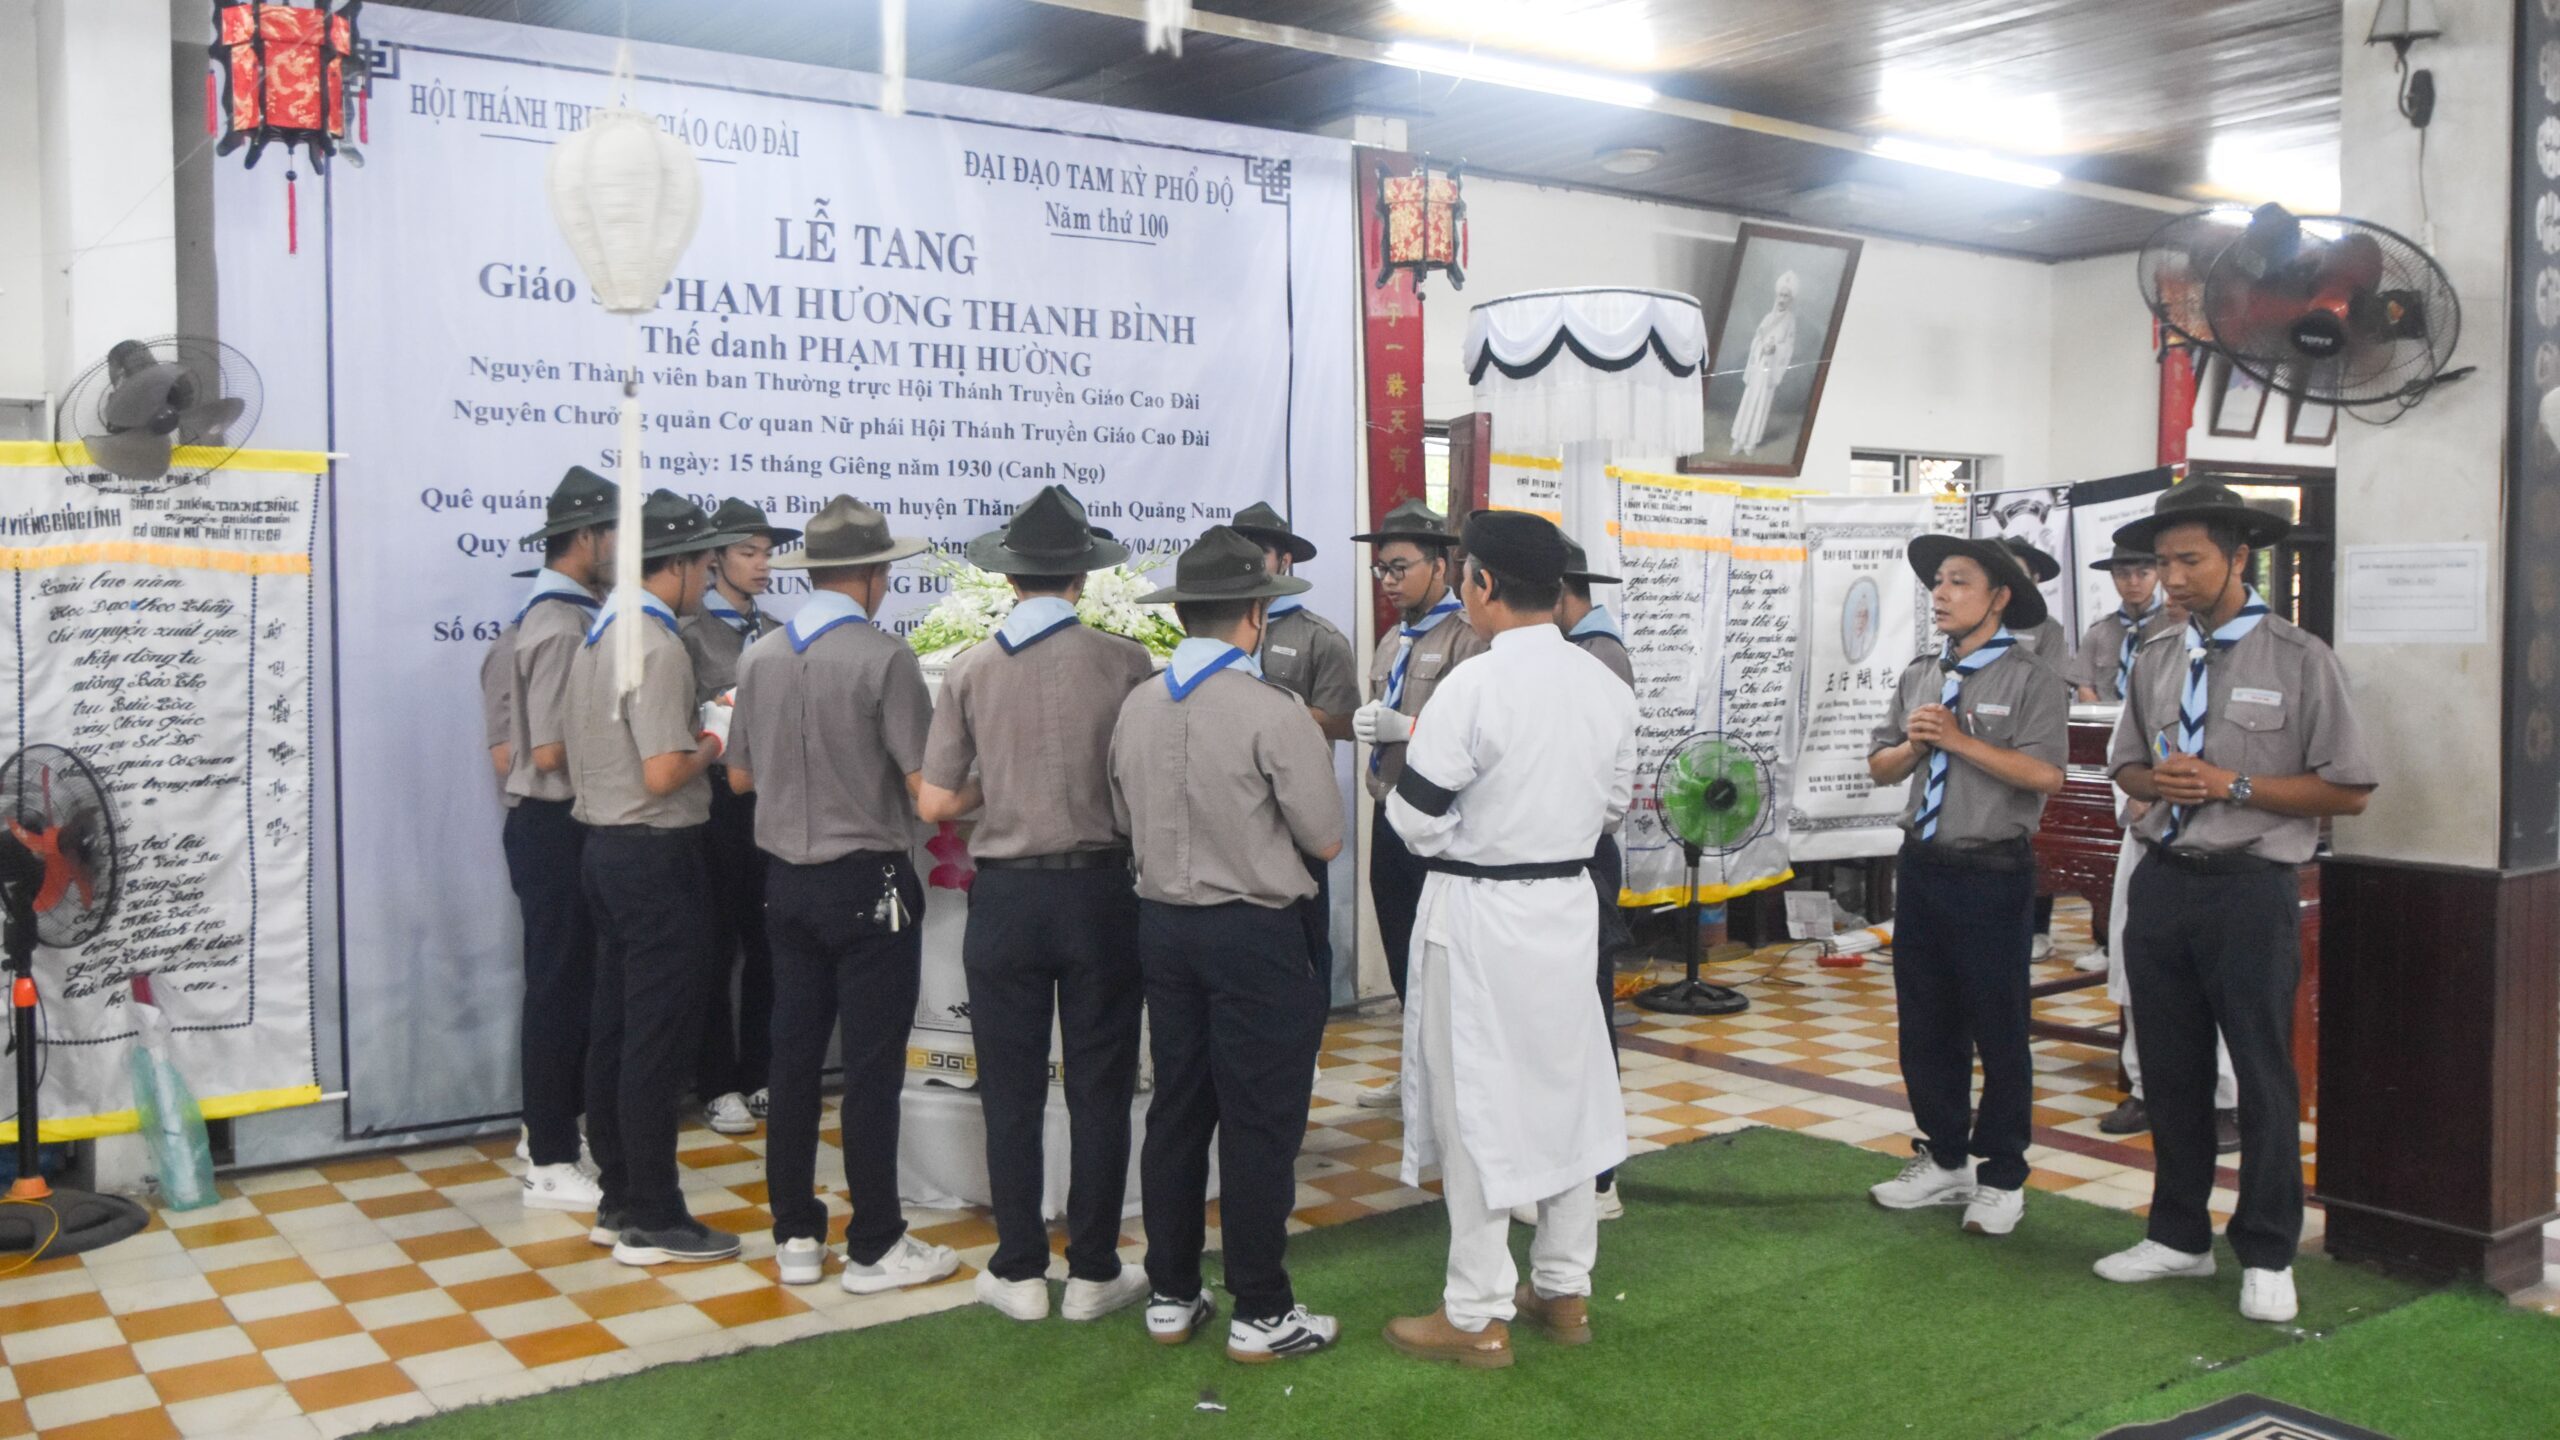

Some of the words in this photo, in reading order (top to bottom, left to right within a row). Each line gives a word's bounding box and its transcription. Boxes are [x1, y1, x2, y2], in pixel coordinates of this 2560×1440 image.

[410, 77, 456, 125] HỘI
[464, 85, 547, 129] THÁNH
[715, 122, 756, 153] CAO
[762, 120, 799, 158] ĐÀI
[964, 151, 1005, 185] ĐẠI
[1012, 156, 1060, 190] ĐẠO
[1066, 164, 1113, 194] TAM
[1121, 164, 1147, 197] KỲ
[1155, 166, 1198, 203] PHỔ
[1206, 177, 1234, 212] ĐỘ
[775, 197, 836, 263] LỄ
[855, 225, 978, 275] TANG
[1045, 202, 1091, 231] Năm
[1098, 208, 1133, 234] thứ
[1139, 213, 1169, 239] 100
[479, 262, 576, 303] Giáo
[795, 285, 952, 328] HƯƠNG
[963, 300, 1098, 338] THANH
[1110, 303, 1196, 345] BÌNH
[641, 321, 700, 355] Thế
[711, 330, 787, 361] danh
[799, 335, 899, 372] PHẠM
[909, 342, 966, 377] THỊ
[977, 343, 1091, 377] HƯỜNG
[470, 356, 560, 382] Nguyên
[569, 362, 644, 385] Thành
[653, 367, 698, 387] viên
[706, 369, 746, 389] ban
[755, 371, 841, 398] Thường
[848, 379, 893, 398] trực
[898, 379, 933, 398] Hội
[939, 380, 1001, 401] Thánh
[1009, 382, 1074, 407] Truyền
[1081, 388, 1124, 406] Giáo
[1130, 390, 1164, 408] Cao
[1170, 391, 1200, 410] Đài
[453, 399, 546, 425] Nguyên
[554, 404, 648, 430] Chưởg
[656, 409, 711, 431] quản
[719, 411, 751, 430] Cơ
[759, 416, 812, 435] quan
[821, 414, 854, 434] Nữ
[860, 418, 904, 439] phái
[911, 418, 946, 439] Hội
[952, 420, 1015, 440] Thánh
[1021, 421, 1087, 445] Truyền
[1094, 425, 1135, 444] Giáo
[1141, 428, 1176, 445] Cao
[1182, 429, 1210, 447] Đài
[600, 449, 651, 469] Sih
[659, 454, 719, 473] ngày:
[729, 454, 753, 471] 15
[761, 455, 821, 478] tháng
[829, 456, 891, 480] Giêng
[899, 459, 939, 476] năm
[948, 459, 992, 478] 1930
[999, 460, 1056, 480] (Canh
[1063, 463, 1106, 483] Ngọ)
[421, 487, 473, 512] Quê
[900, 498, 957, 519] huyện
[1088, 501, 1122, 518] tỉnh
[1129, 501, 1186, 522] Quảng
[1192, 502, 1231, 518] Nam
[457, 533, 511, 558] Quy
[434, 616, 464, 642] Số
